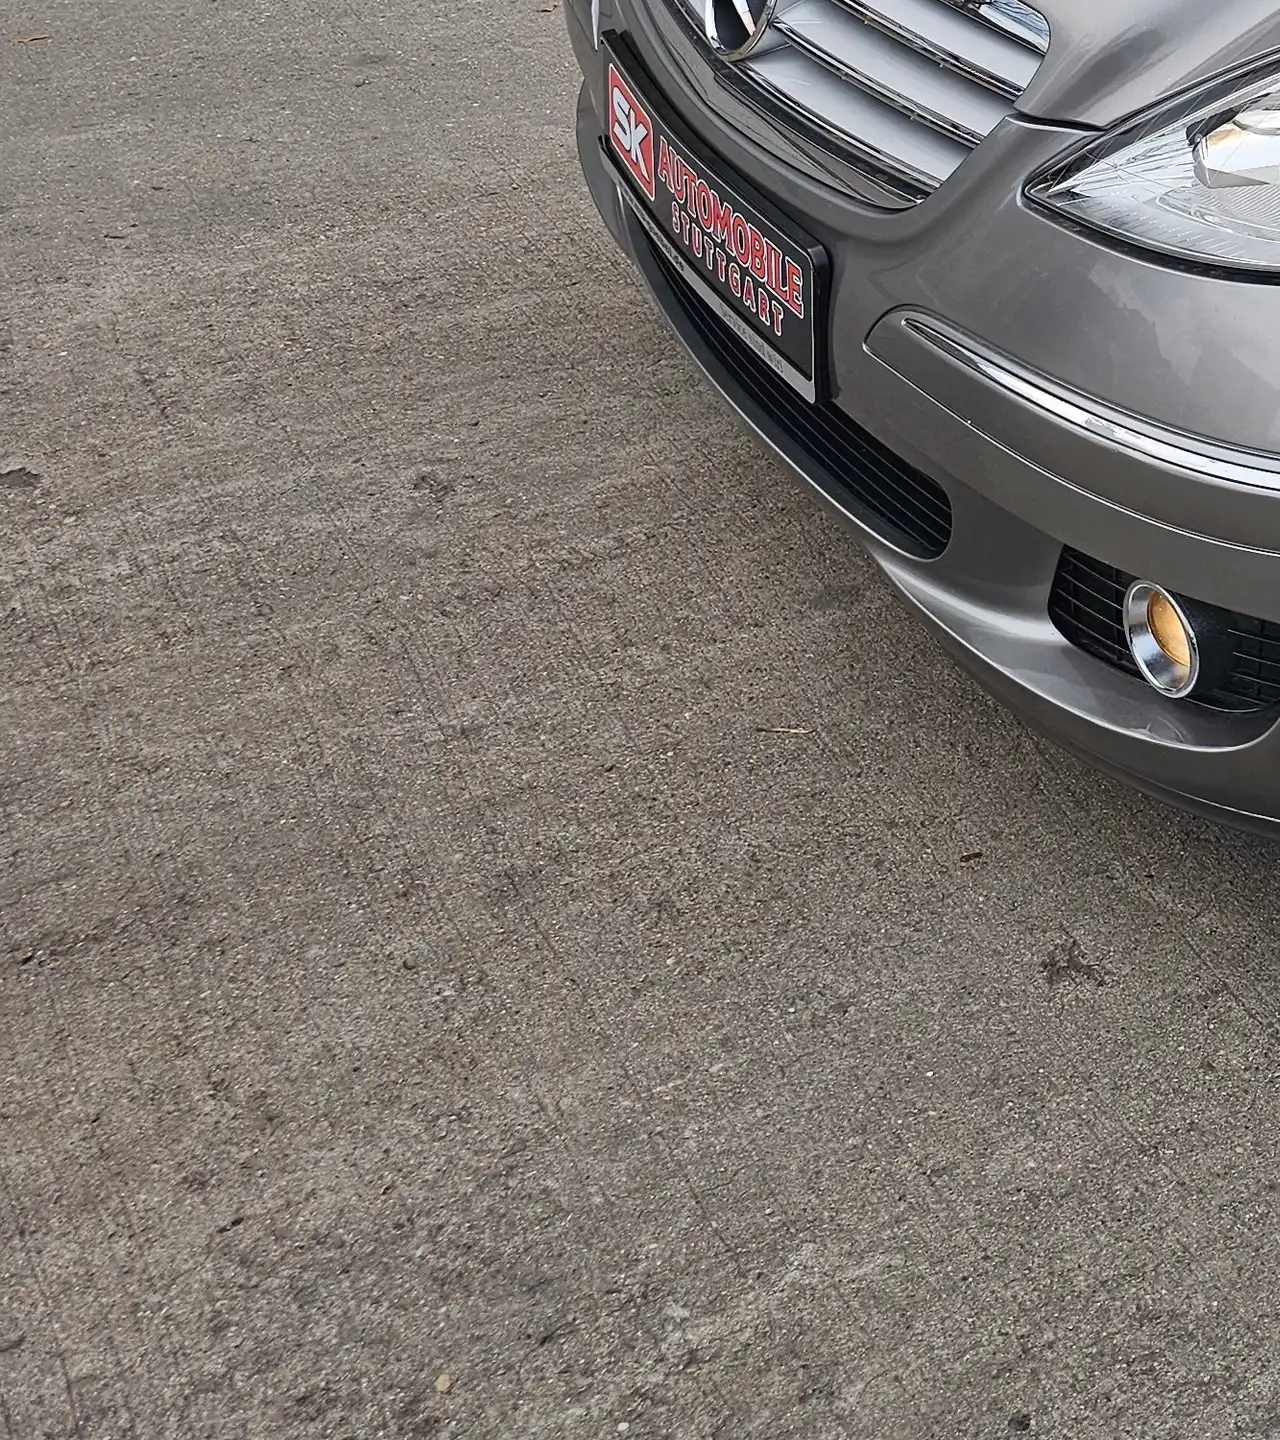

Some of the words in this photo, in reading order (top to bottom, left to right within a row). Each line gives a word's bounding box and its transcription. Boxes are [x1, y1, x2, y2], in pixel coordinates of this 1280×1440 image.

[612, 86, 649, 180] SK
[658, 135, 805, 320] AUTOMOBILE
[671, 201, 784, 337] STUTTGART
